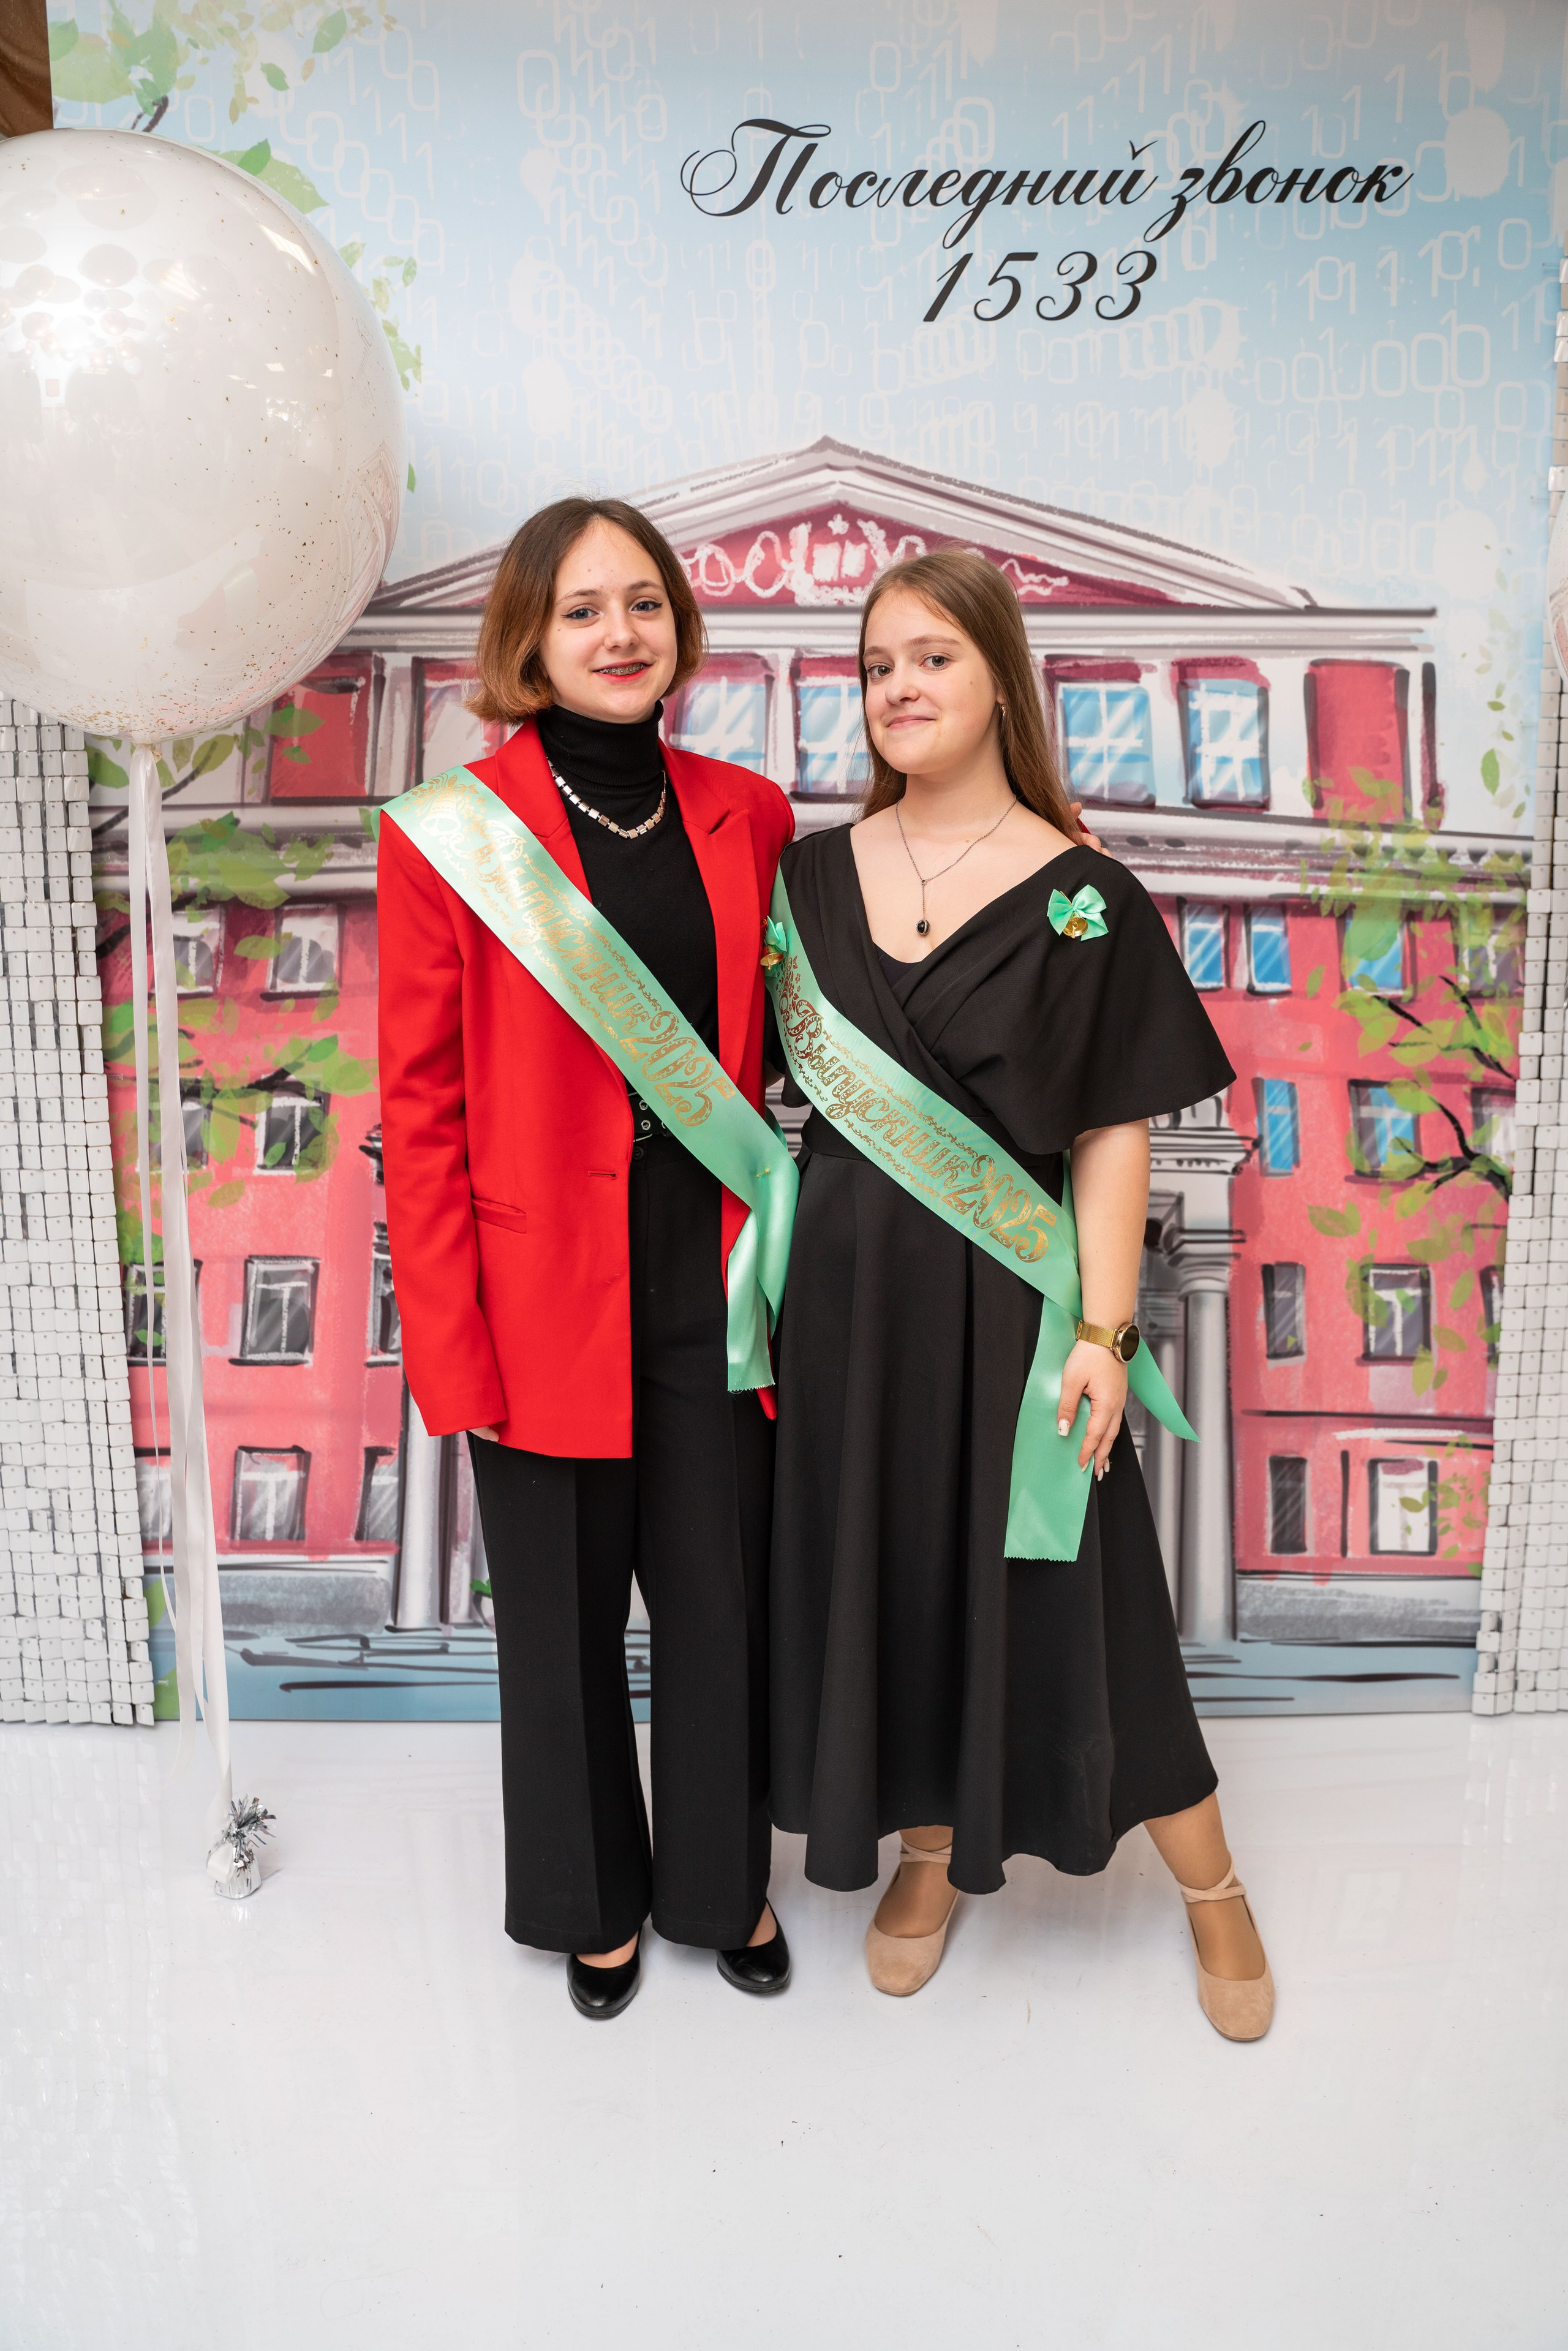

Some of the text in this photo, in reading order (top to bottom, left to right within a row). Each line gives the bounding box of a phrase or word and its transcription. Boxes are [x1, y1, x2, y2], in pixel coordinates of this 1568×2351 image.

[680, 118, 1158, 249] Последний
[1143, 119, 1415, 243] звонок
[922, 251, 1158, 322] 1533
[619, 1011, 737, 1127] 2025
[785, 999, 1057, 1263] Выпускник 2025
